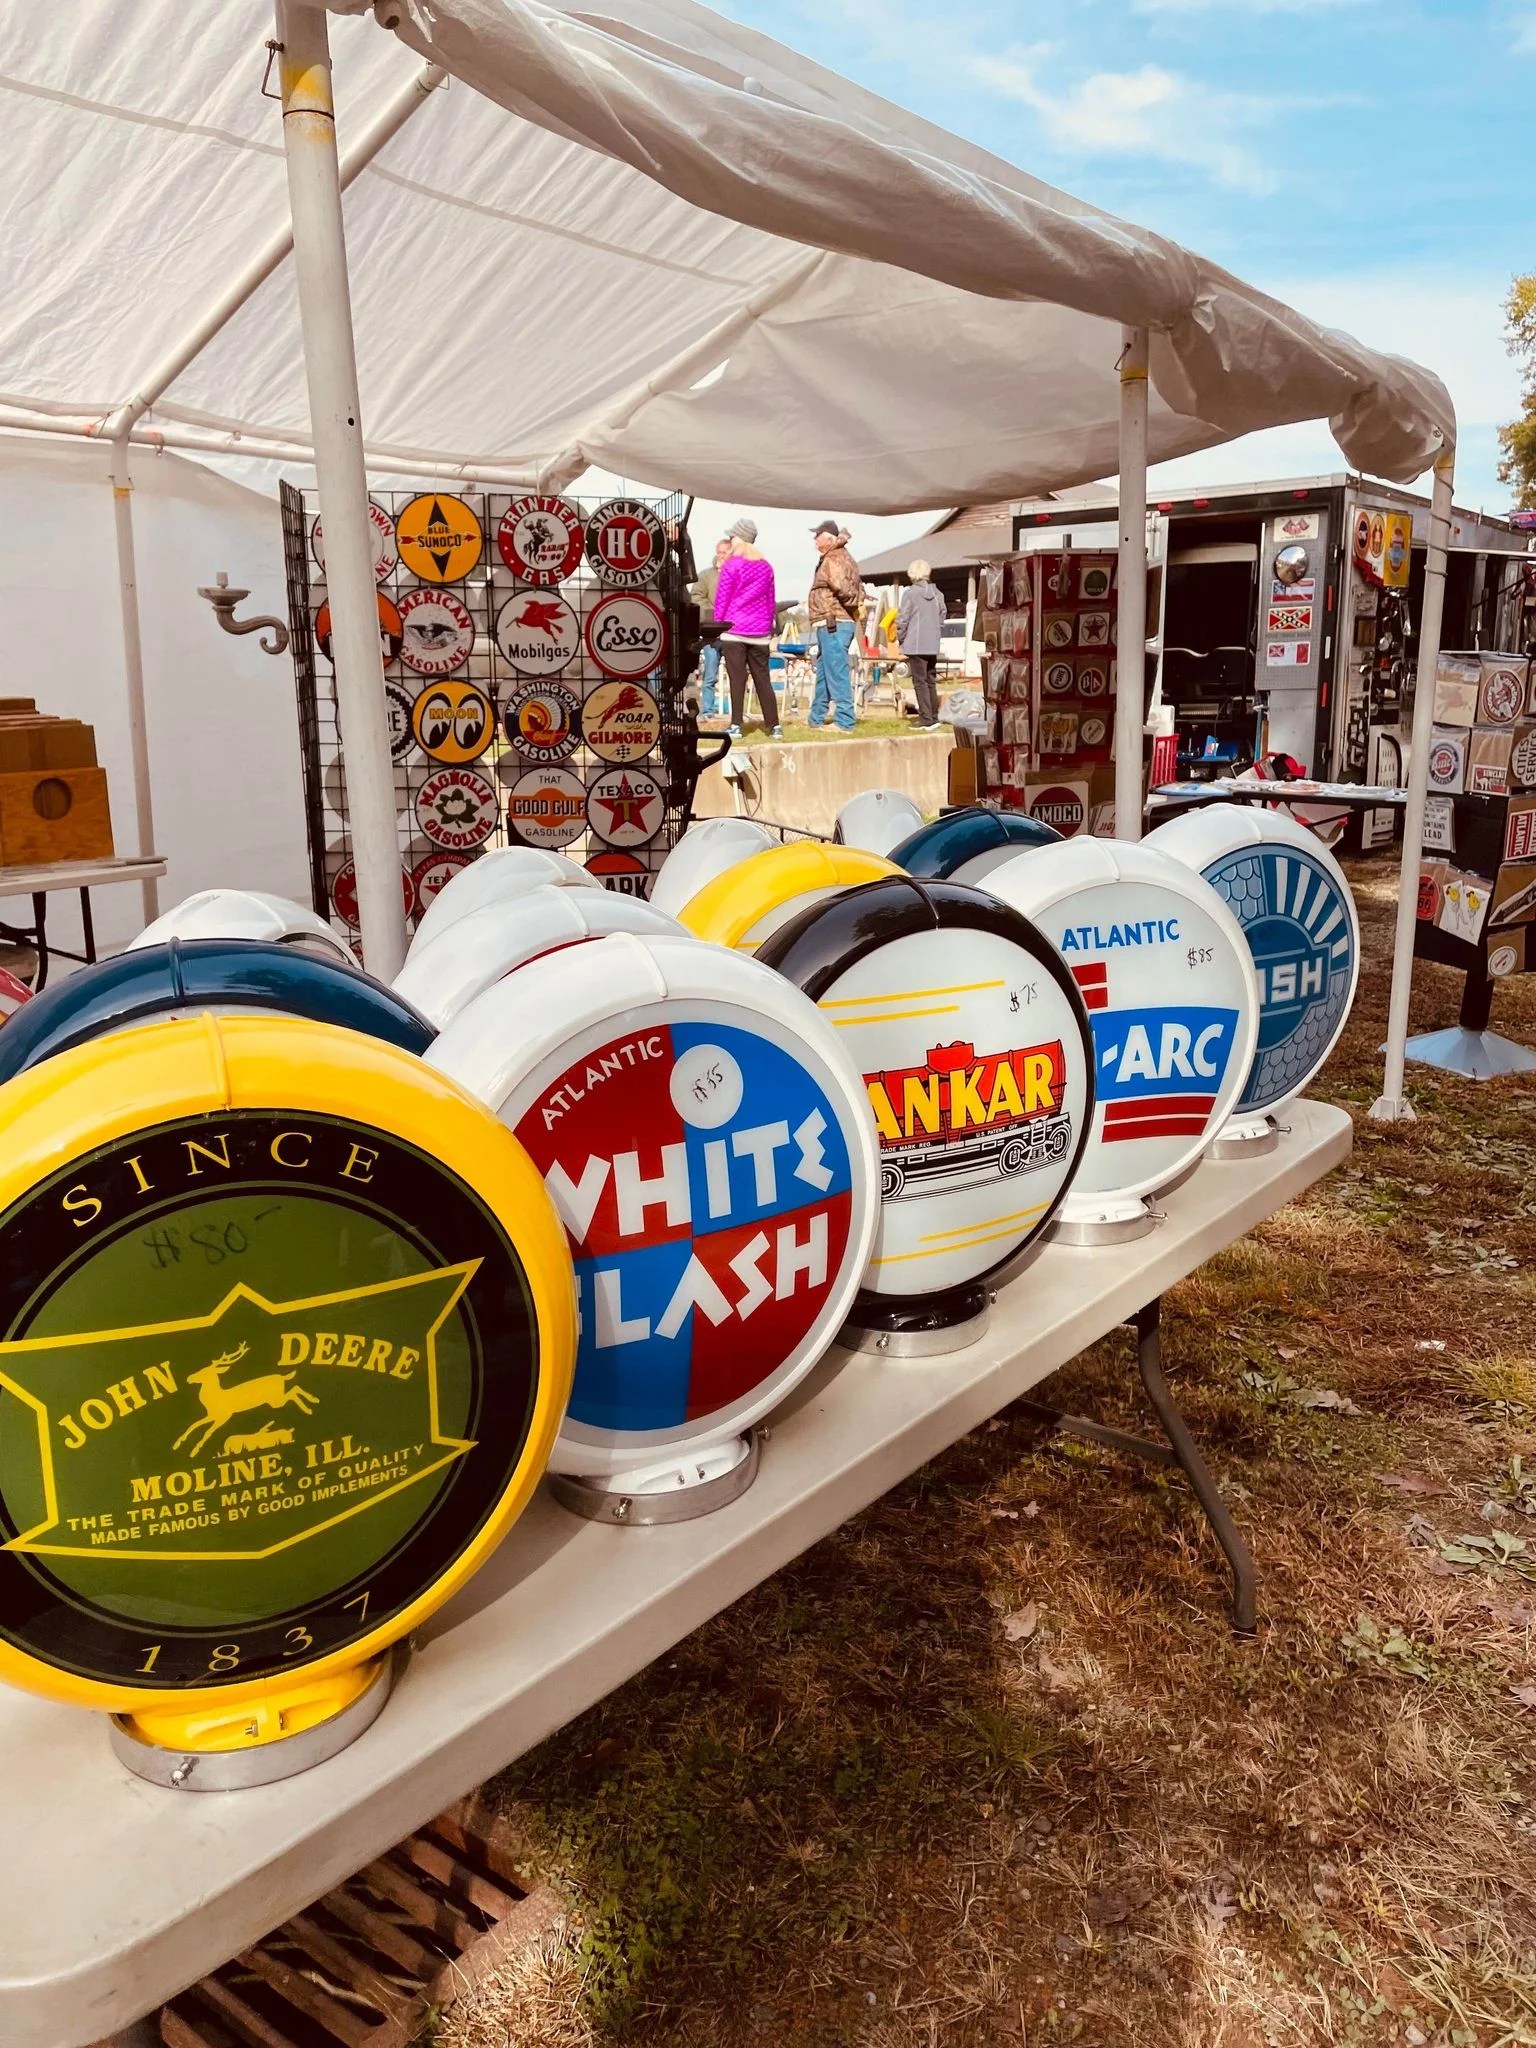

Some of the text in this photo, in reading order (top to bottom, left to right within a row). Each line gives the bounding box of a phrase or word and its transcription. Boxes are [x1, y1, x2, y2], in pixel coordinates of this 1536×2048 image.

[428, 526, 450, 534] BLUE
[501, 496, 578, 534] FRONTIER
[590, 501, 660, 534] SINCLAIR
[418, 534, 462, 548] SUNOCO
[522, 567, 566, 585] GAS
[590, 554, 662, 585] GASOLINE
[397, 591, 472, 629] MERICAN
[596, 615, 658, 653] Esso
[400, 645, 468, 672] GASOLINE
[508, 643, 570, 662] Mobilgas
[506, 682, 580, 714] WASHINGTON
[429, 708, 479, 720] MOON
[615, 712, 655, 724] ROAR
[513, 733, 580, 761] GASOLINE
[589, 731, 653, 745] GILMORE
[1516, 738, 1529, 776] CITIES
[419, 771, 493, 808] MAGNOLIA
[539, 775, 562, 784] THAT
[598, 783, 655, 797] TEXACO
[514, 799, 585, 816] GOOD GULF
[1033, 805, 1082, 823] AMOCO
[424, 816, 493, 847] GASOLINE
[525, 828, 575, 837] GASOLINE
[1424, 821, 1446, 831] ONTAINS
[1424, 829, 1442, 840] LEAD
[1513, 815, 1528, 856] ATLANTIC
[1062, 918, 1179, 951] ATLANTIC
[1187, 947, 1213, 969] $85
[1094, 1023, 1225, 1083] -ARC
[541, 1036, 664, 1131] ATLANTIC
[867, 1053, 1056, 1140] ANKAR
[987, 1127, 1006, 1136] PATENT
[62, 1132, 380, 1228] SINCE
[544, 1106, 834, 1247] WHITE
[574, 1212, 829, 1350] LASH
[58, 1333, 420, 1449] JOHN DEERE
[131, 1434, 371, 1502] MOLINE, ILL.
[67, 1444, 424, 1531] THE TRADE MARK OF QUALITY
[91, 1465, 408, 1545] MADE FAMOUS BY GOOD IMPLEMENTS
[136, 1591, 371, 1673] 1837
